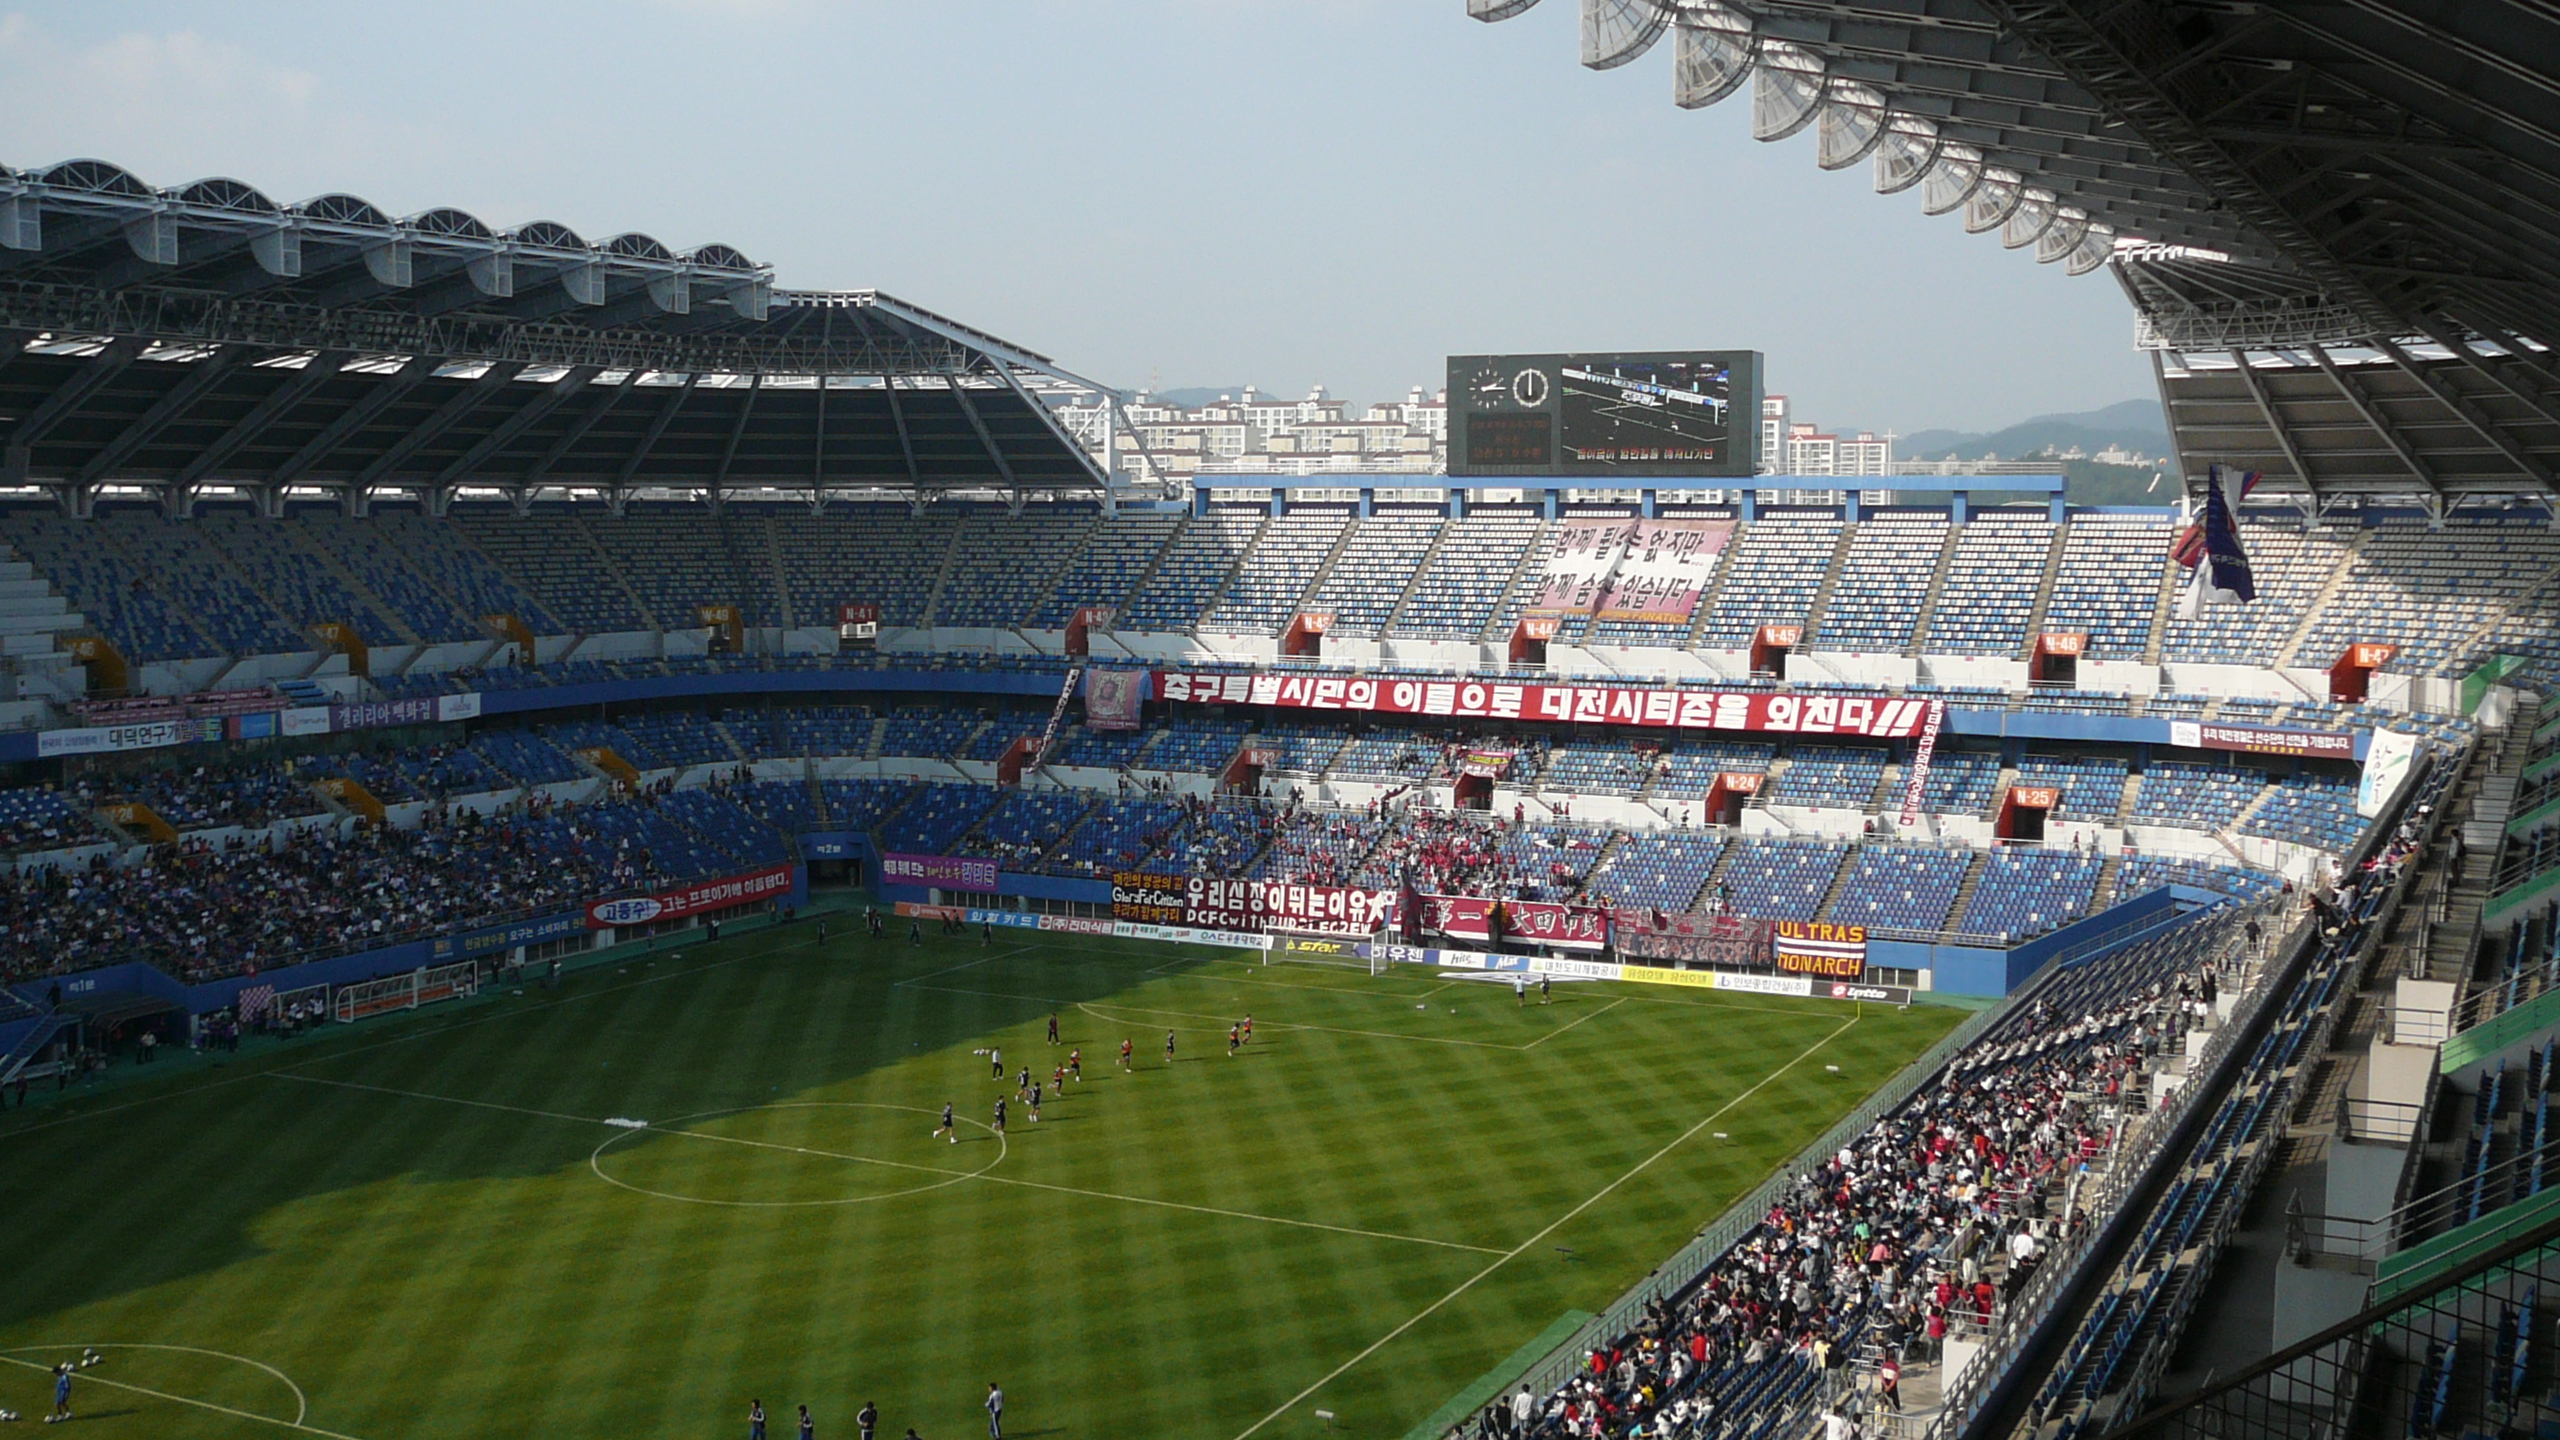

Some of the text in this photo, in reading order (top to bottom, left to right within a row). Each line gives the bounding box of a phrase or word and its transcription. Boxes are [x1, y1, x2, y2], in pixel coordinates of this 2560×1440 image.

[1555, 528, 1597, 559] 함께
[1531, 573, 1577, 606] 함께
[1615, 575, 1693, 608] 있습니다
[702, 609, 729, 622] W-49
[846, 608, 872, 620] N-41
[1632, 612, 1689, 623] FANATICS
[1527, 622, 1553, 636] N-44
[1766, 629, 1795, 643] N-45
[2046, 636, 2078, 651] N-46
[1164, 673, 1925, 737] 축구특별시민의 이름으로 대전시티즌을 외친다!!
[339, 703, 390, 728] 갤러리아
[393, 699, 431, 720] 백화점
[109, 719, 222, 747] 대덕연구개발특구
[2203, 728, 2217, 740] 우리
[1727, 775, 1755, 789] N-24
[2018, 790, 2049, 805] N-25
[604, 899, 652, 921] 고종수!
[663, 895, 687, 912] 그는
[1510, 904, 1603, 939] 大田市民
[510, 927, 533, 942] 요구는
[1779, 921, 1863, 943] ULTRAS
[1298, 941, 1342, 954] star
[1373, 946, 1424, 963] 하우젠
[1450, 953, 1472, 965] hite
[1778, 954, 1860, 976] MONARCH
[1545, 961, 1619, 978] 대전도시개발공사
[1628, 968, 1707, 984] 유성호텔 유성호텔
